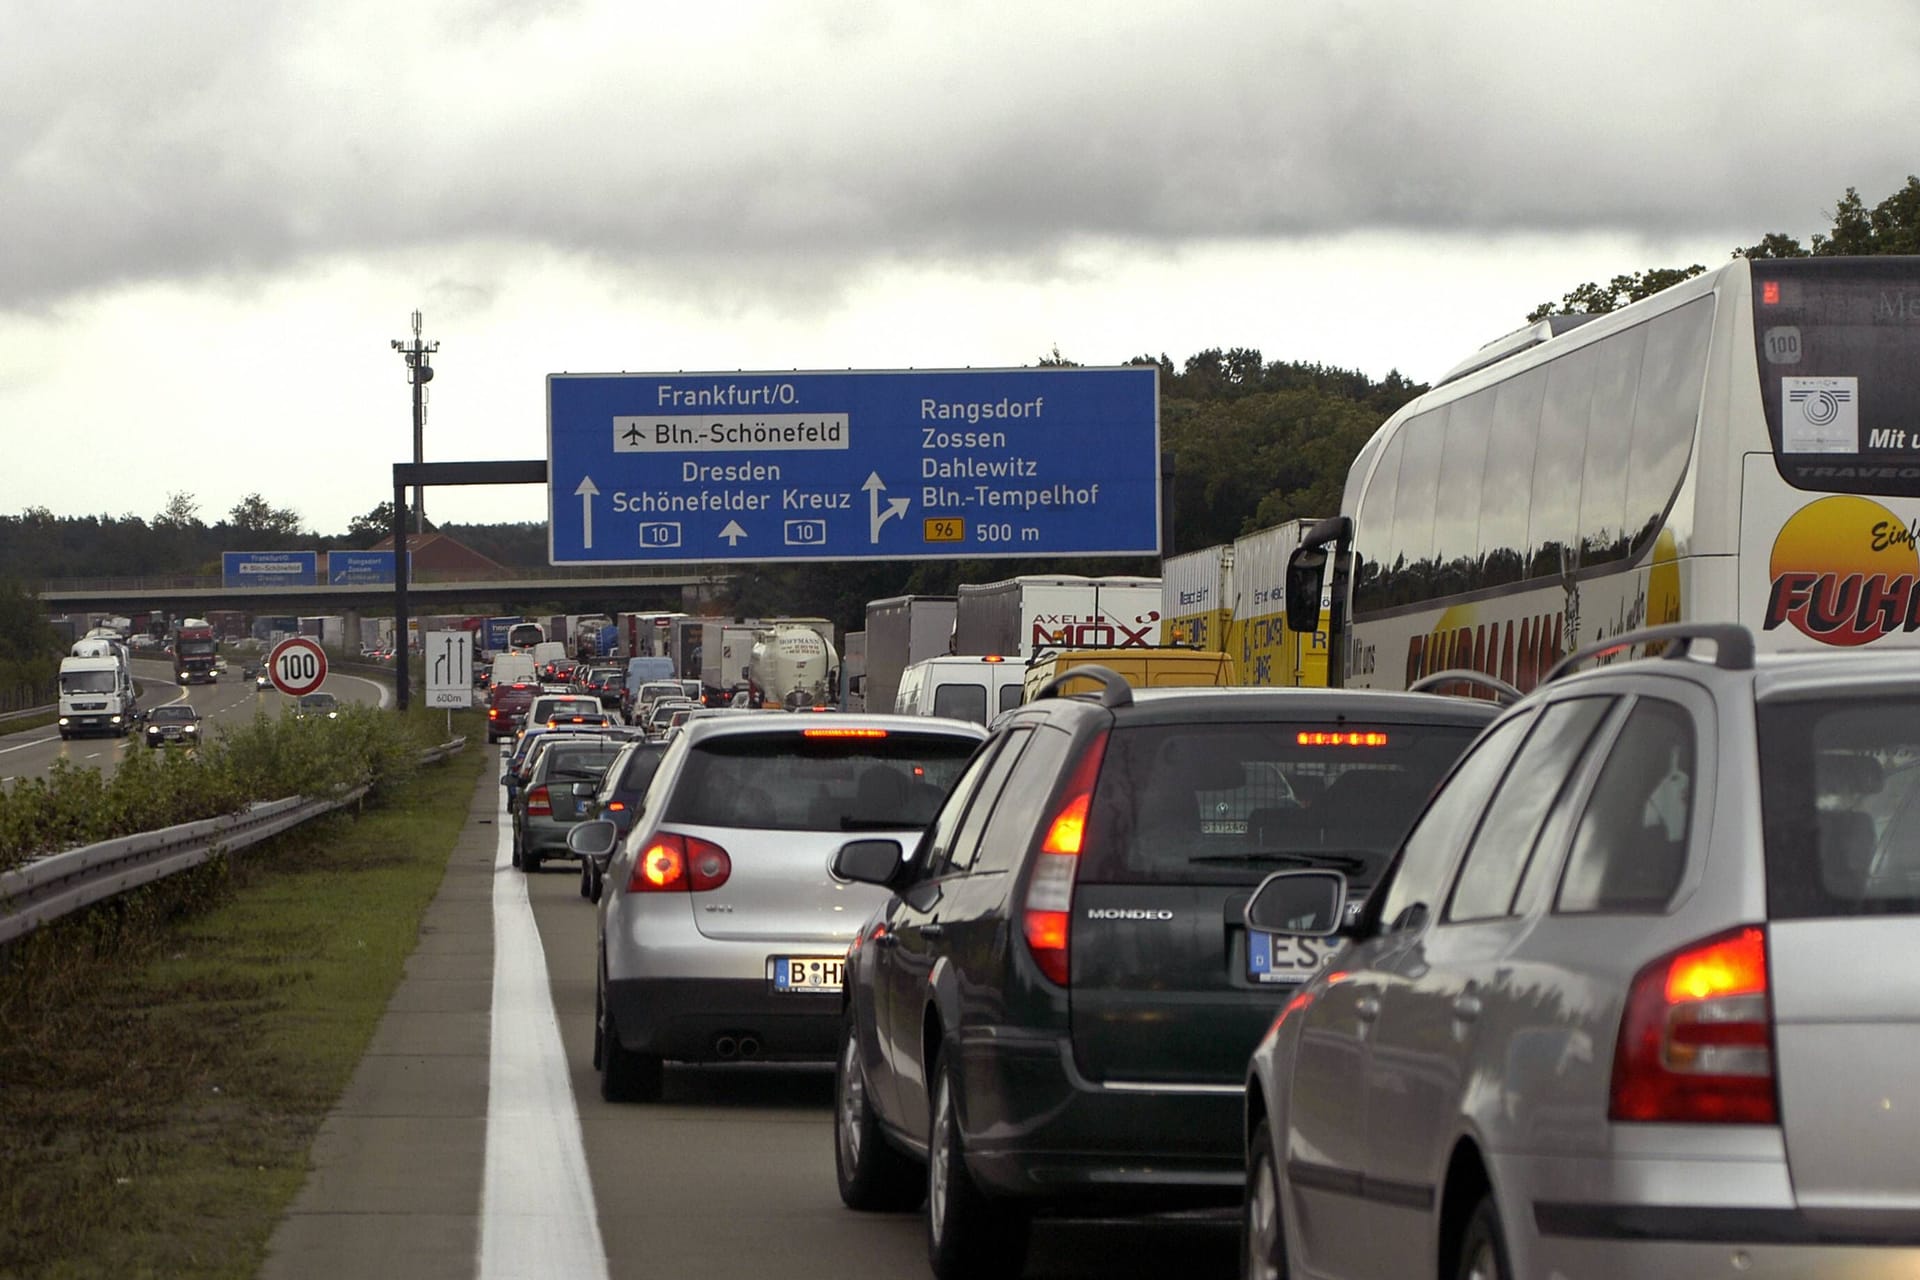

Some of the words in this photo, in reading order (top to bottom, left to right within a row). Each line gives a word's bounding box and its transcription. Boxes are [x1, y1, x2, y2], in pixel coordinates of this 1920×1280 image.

[1769, 335, 1797, 354] 100
[658, 383, 800, 406] Frankfurt/O.
[921, 397, 1043, 423] Rangsdorf
[655, 421, 841, 444] Bln.-Schönefeld
[922, 428, 1006, 449] Zossen
[1869, 428, 1906, 449] Mit
[682, 461, 781, 482] Dresden
[922, 456, 1037, 478] Dahlewitz
[612, 491, 770, 513] Schönefelder
[783, 489, 851, 510] Kreuz
[922, 484, 1099, 510] Bln.-Tempelhof
[651, 527, 669, 543] 10
[796, 524, 813, 541] 10
[935, 523, 953, 537] 96
[976, 524, 1012, 542] 500
[1021, 526, 1040, 541] m
[1033, 614, 1080, 624] AXEL
[280, 652, 315, 680] 100
[1088, 908, 1173, 920] MONDEO
